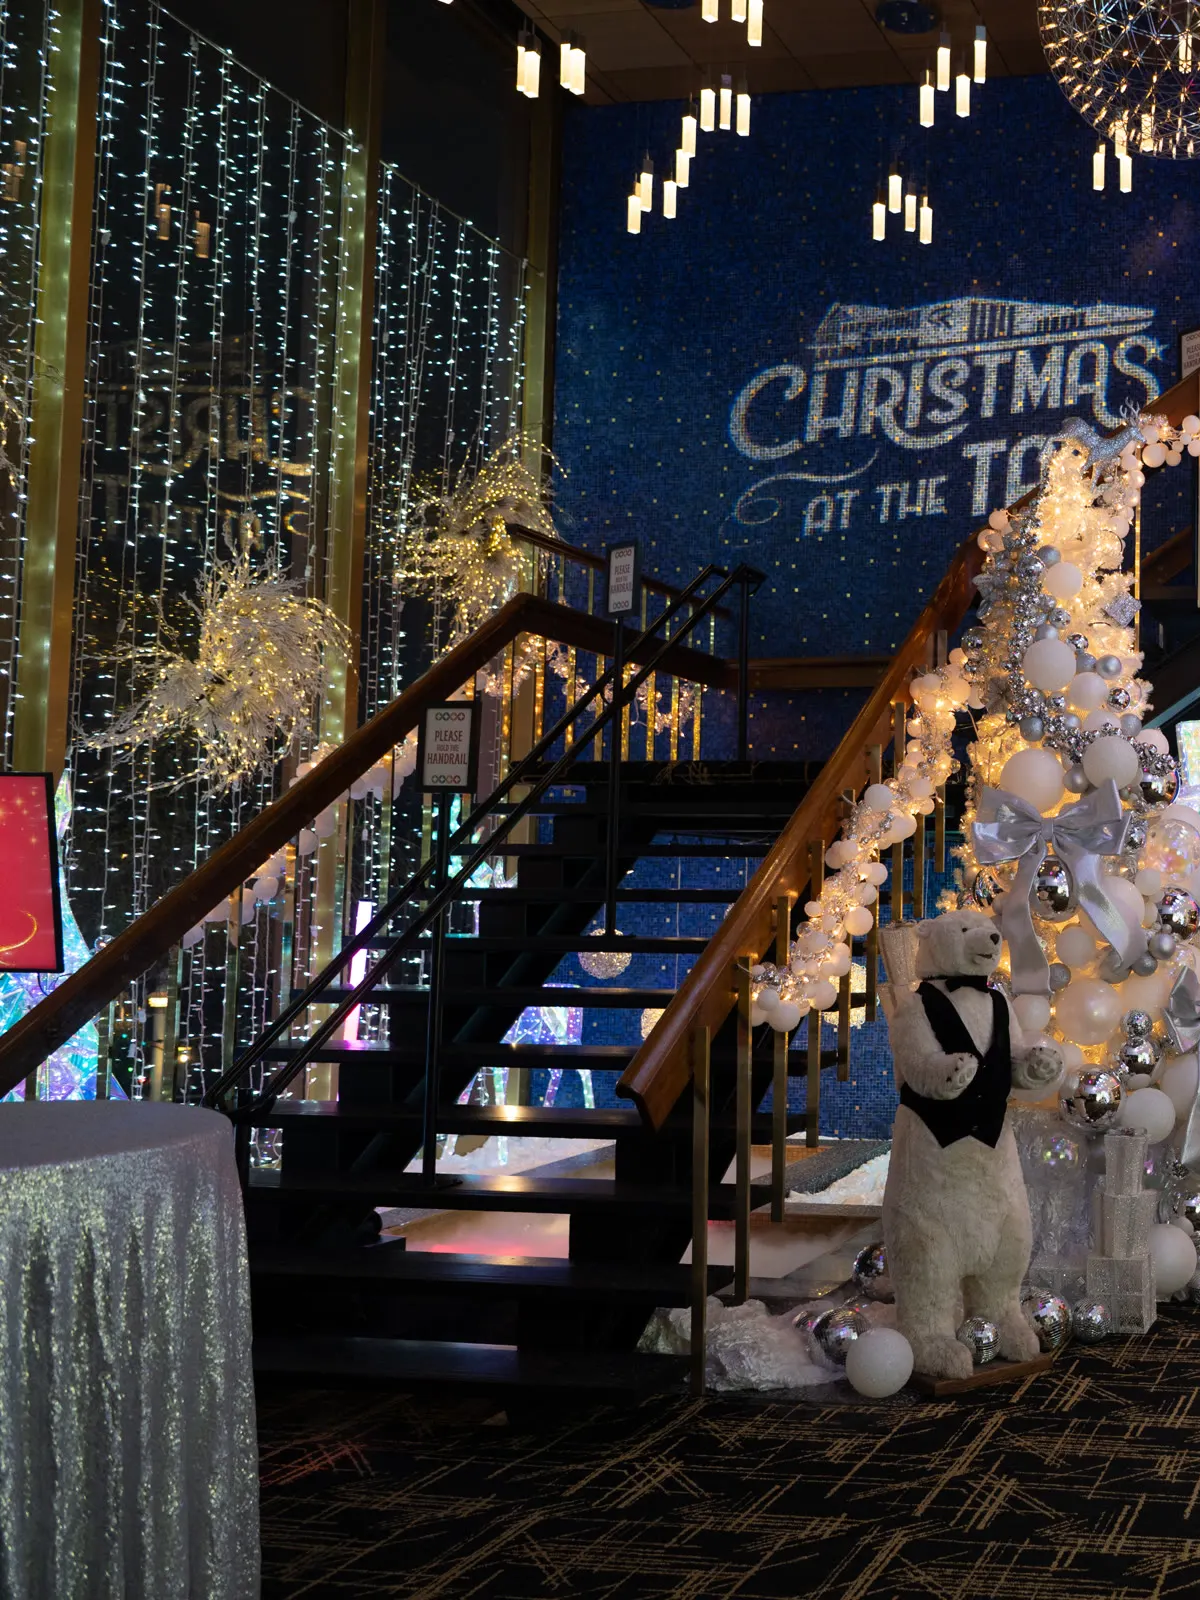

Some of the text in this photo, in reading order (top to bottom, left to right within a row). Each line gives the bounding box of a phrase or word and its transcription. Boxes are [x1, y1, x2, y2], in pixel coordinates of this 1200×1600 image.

[729, 335, 1161, 461] CHRISTMAS
[804, 434, 1052, 535] AT THE TO
[427, 753, 467, 765] HANDRAIL
[434, 730, 464, 742] PLEASE
